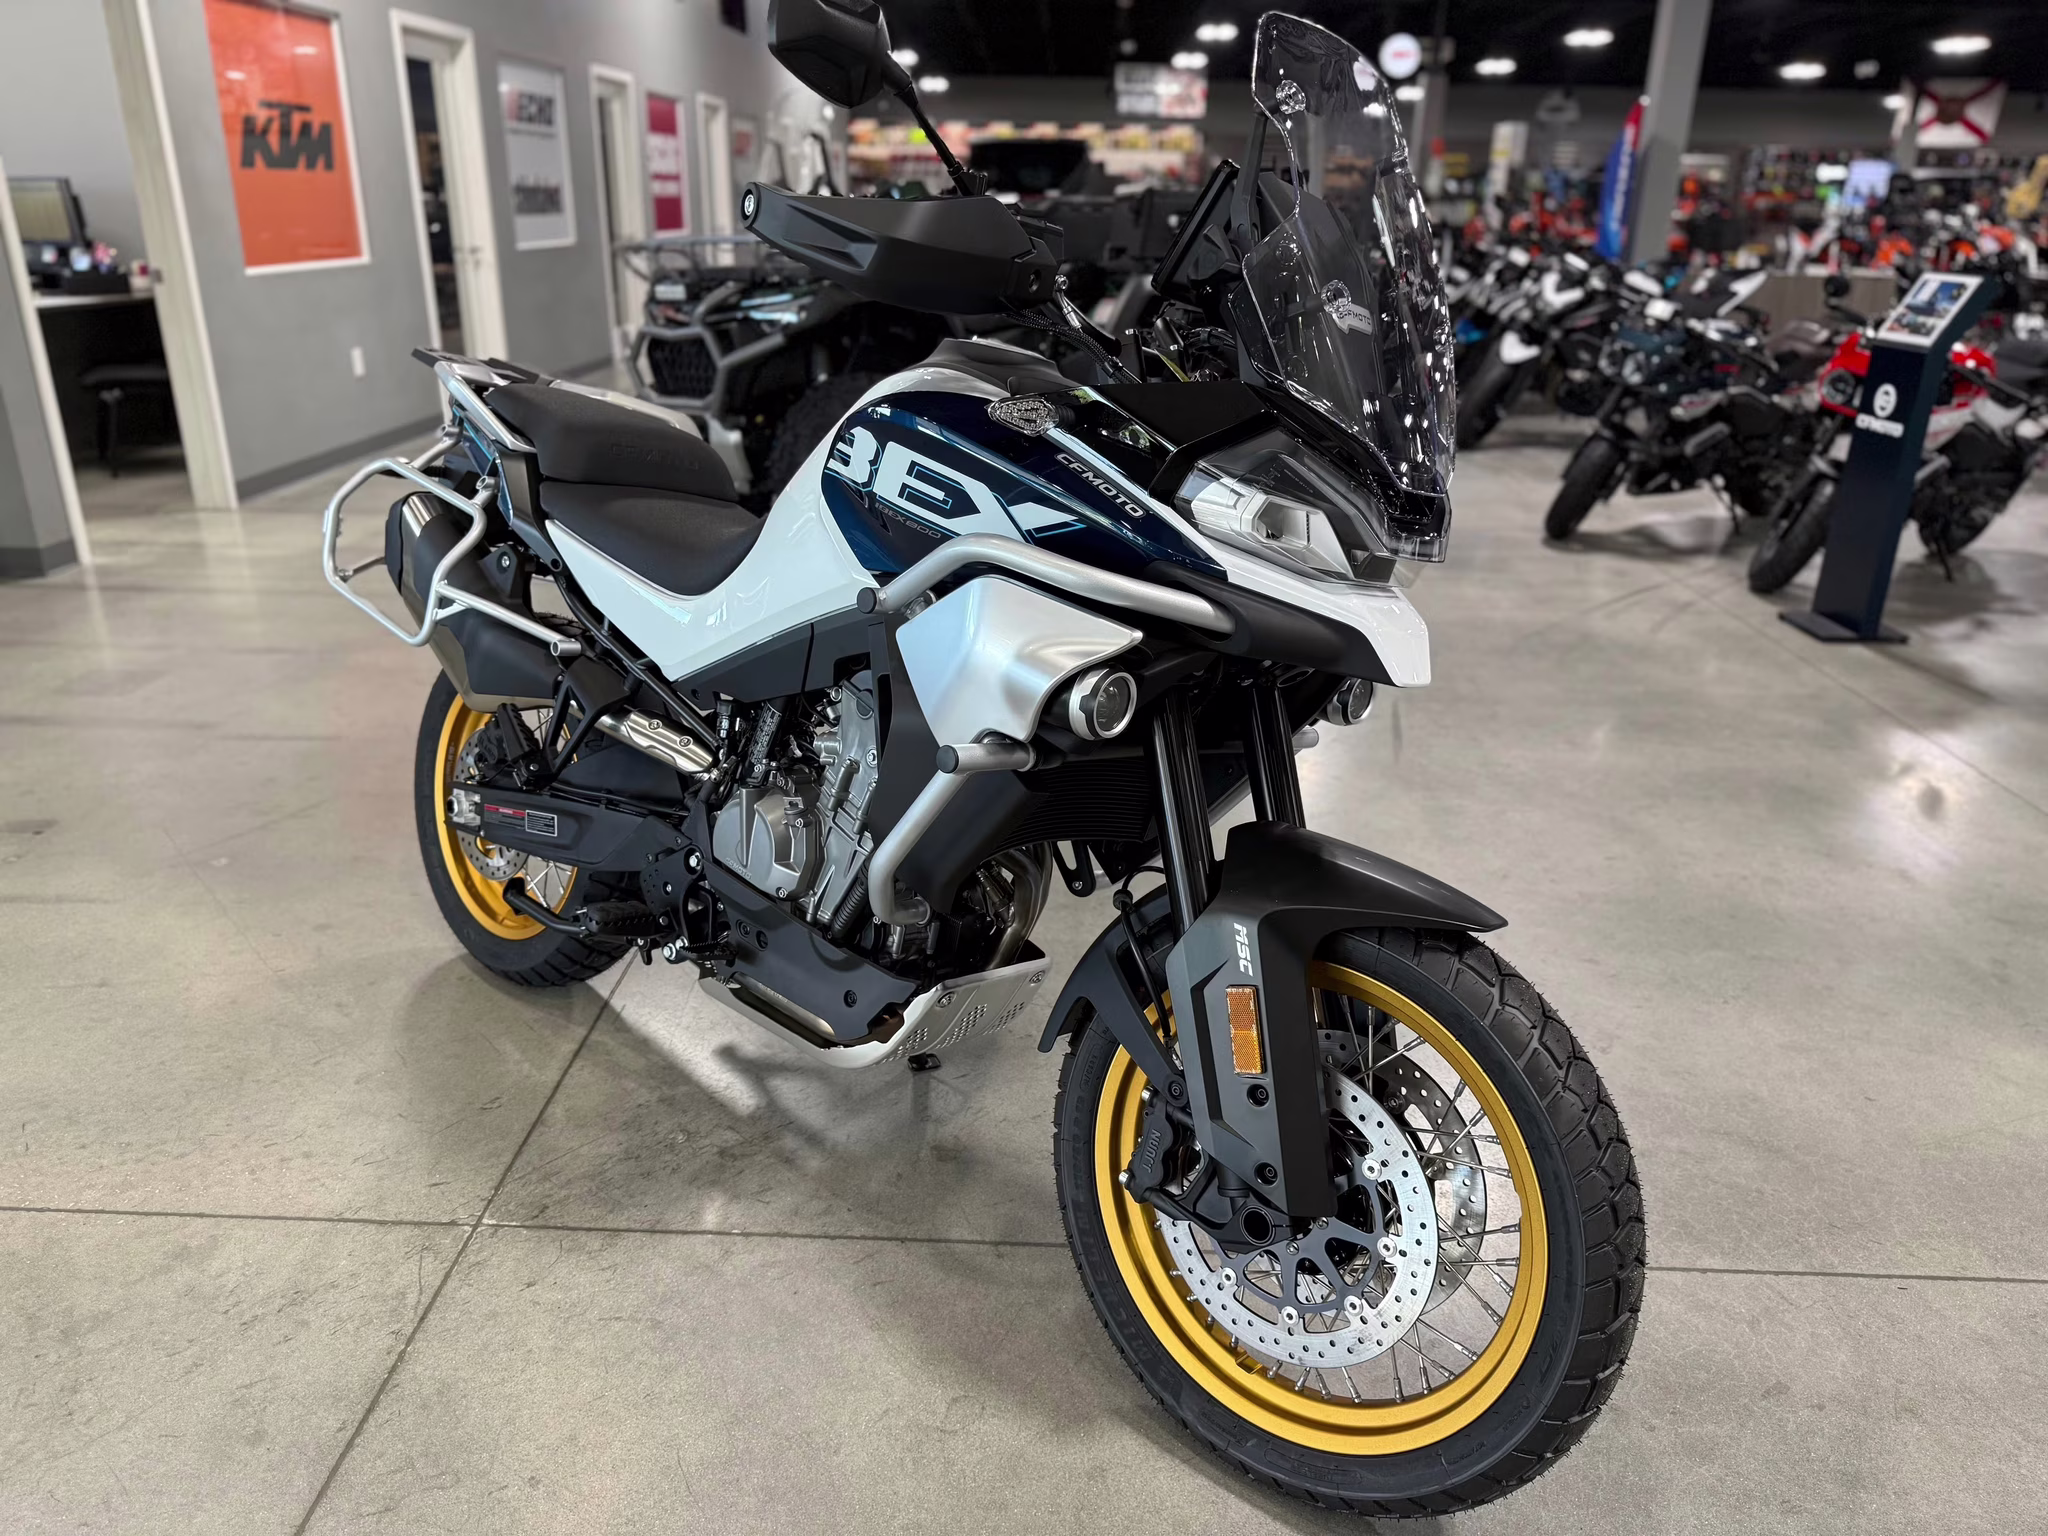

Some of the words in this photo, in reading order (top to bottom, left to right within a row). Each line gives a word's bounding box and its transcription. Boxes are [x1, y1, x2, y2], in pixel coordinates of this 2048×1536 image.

[240, 99, 335, 170] KTM
[1056, 453, 1144, 517] CFMOTO
[1233, 922, 1254, 977] MSC
[1142, 1128, 1161, 1174] J.JUAN
